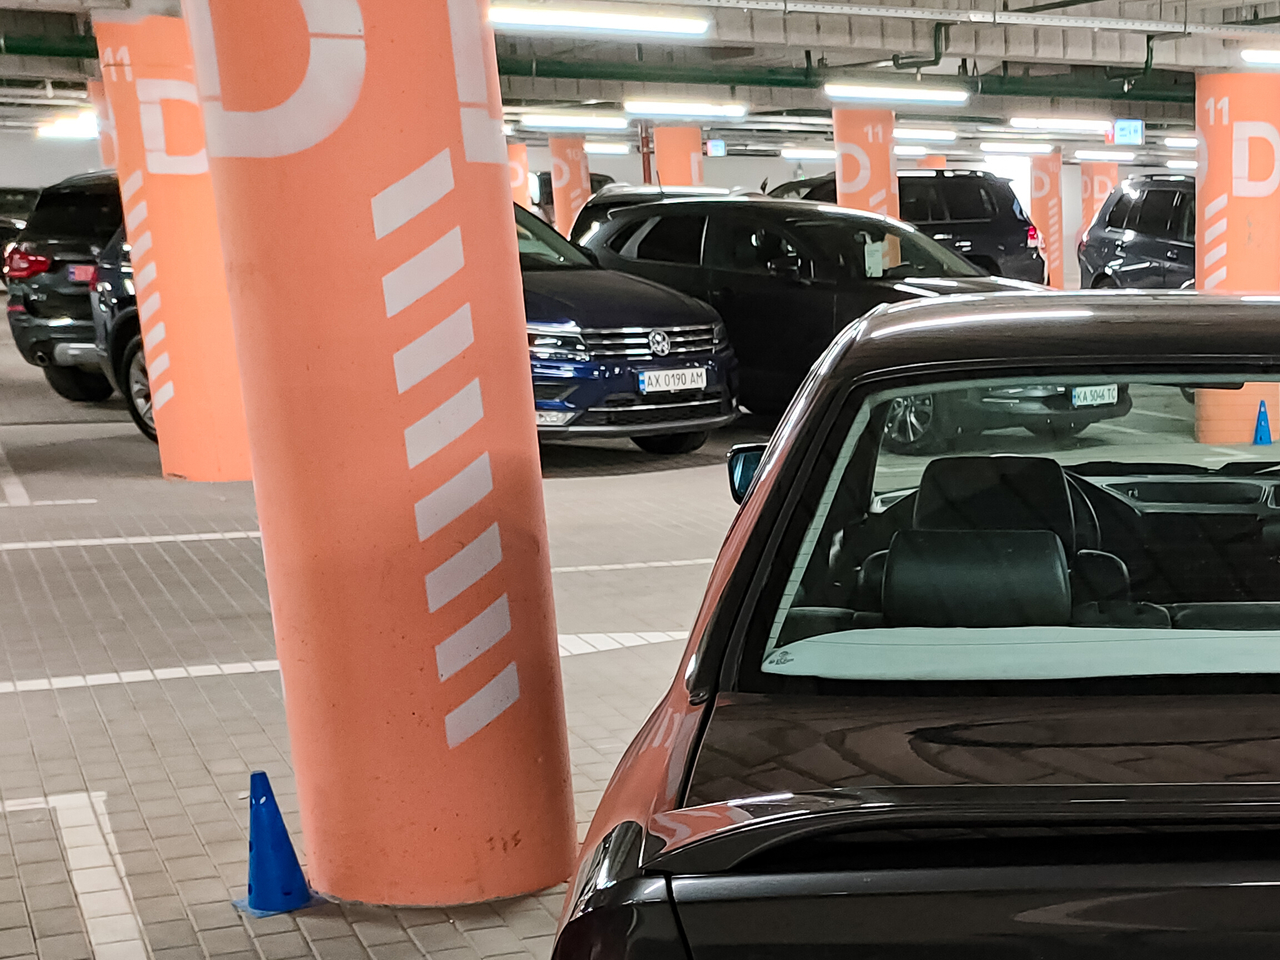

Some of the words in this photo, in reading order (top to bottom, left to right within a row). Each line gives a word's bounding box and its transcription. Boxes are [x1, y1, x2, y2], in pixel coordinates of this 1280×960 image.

[103, 46, 133, 82] 11
[1205, 96, 1229, 125] 11
[136, 78, 209, 175] D
[864, 124, 883, 143] 11
[552, 157, 570, 188] D
[834, 142, 871, 194] D
[1031, 170, 1050, 198] D
[1094, 175, 1112, 199] D
[647, 374, 662, 388] AX
[664, 373, 687, 387] 0190
[690, 371, 704, 385] AM
[1076, 390, 1088, 403] KA
